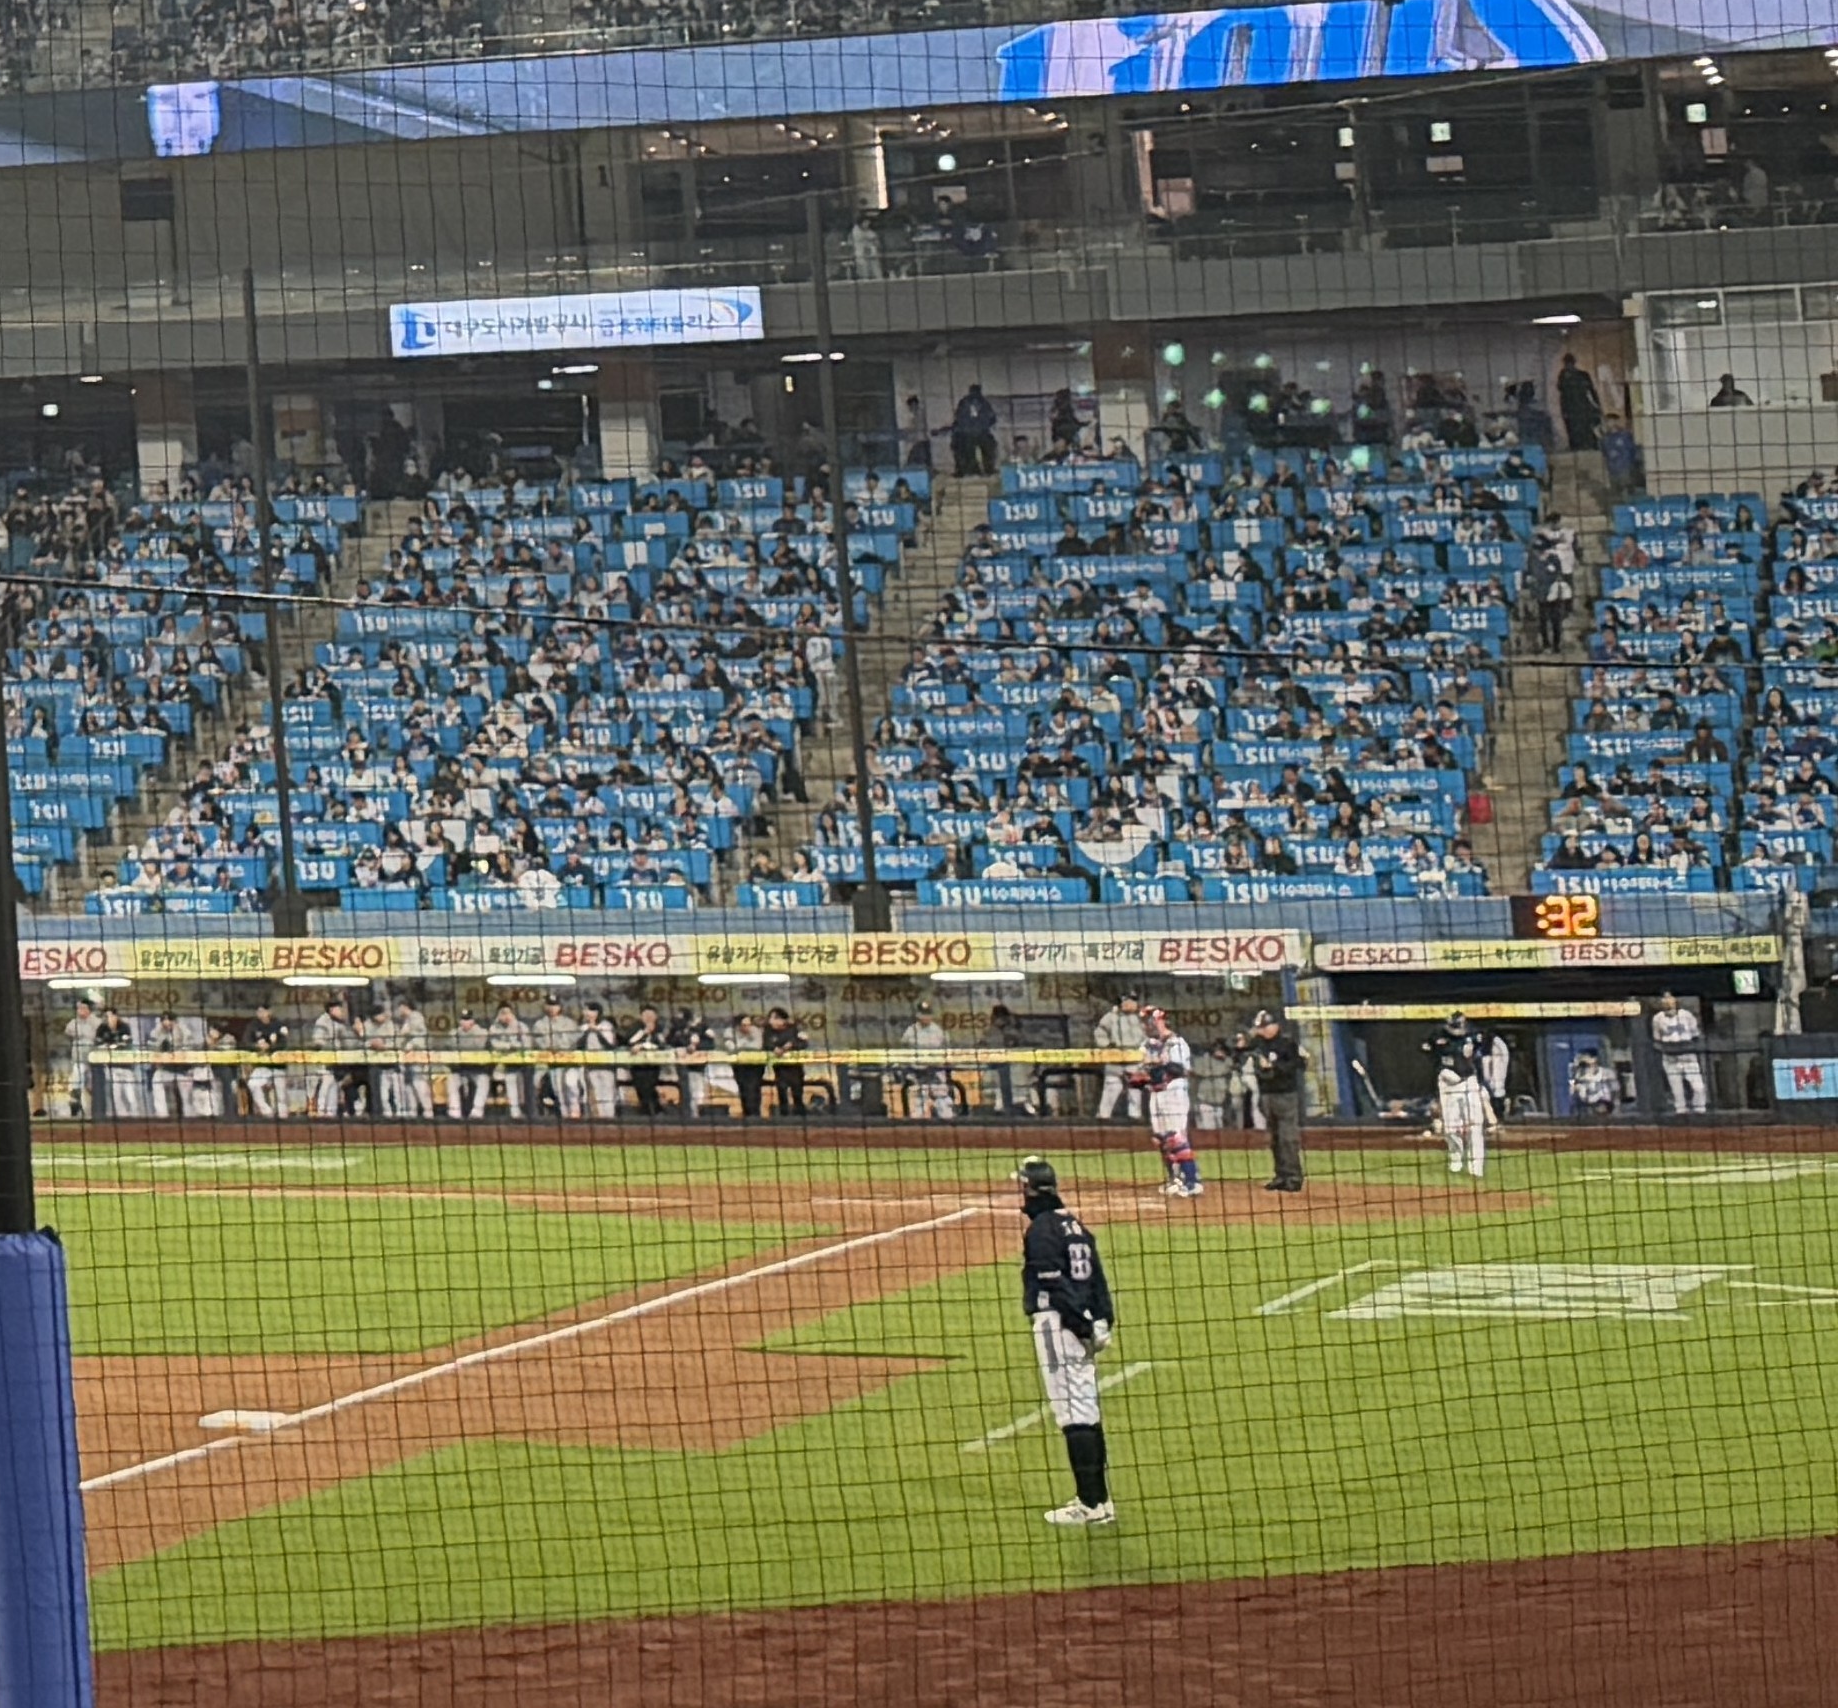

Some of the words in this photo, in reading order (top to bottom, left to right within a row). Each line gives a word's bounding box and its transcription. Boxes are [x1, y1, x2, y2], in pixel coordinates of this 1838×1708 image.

[730, 480, 767, 499] ISU
[998, 500, 1038, 520] ISU
[1082, 497, 1122, 517] ISU
[1461, 545, 1503, 566] ISU
[1222, 880, 1269, 904] ISU
[1550, 874, 1600, 894] ISU
[936, 883, 981, 907] ISU
[22, 947, 107, 972] ESKO
[273, 944, 383, 970] BESKO
[554, 941, 672, 968] BESKO
[850, 939, 972, 966] BESKO
[1158, 935, 1285, 964] BESKO
[1330, 946, 1413, 967] BESKO
[1560, 941, 1645, 962] BESKO
